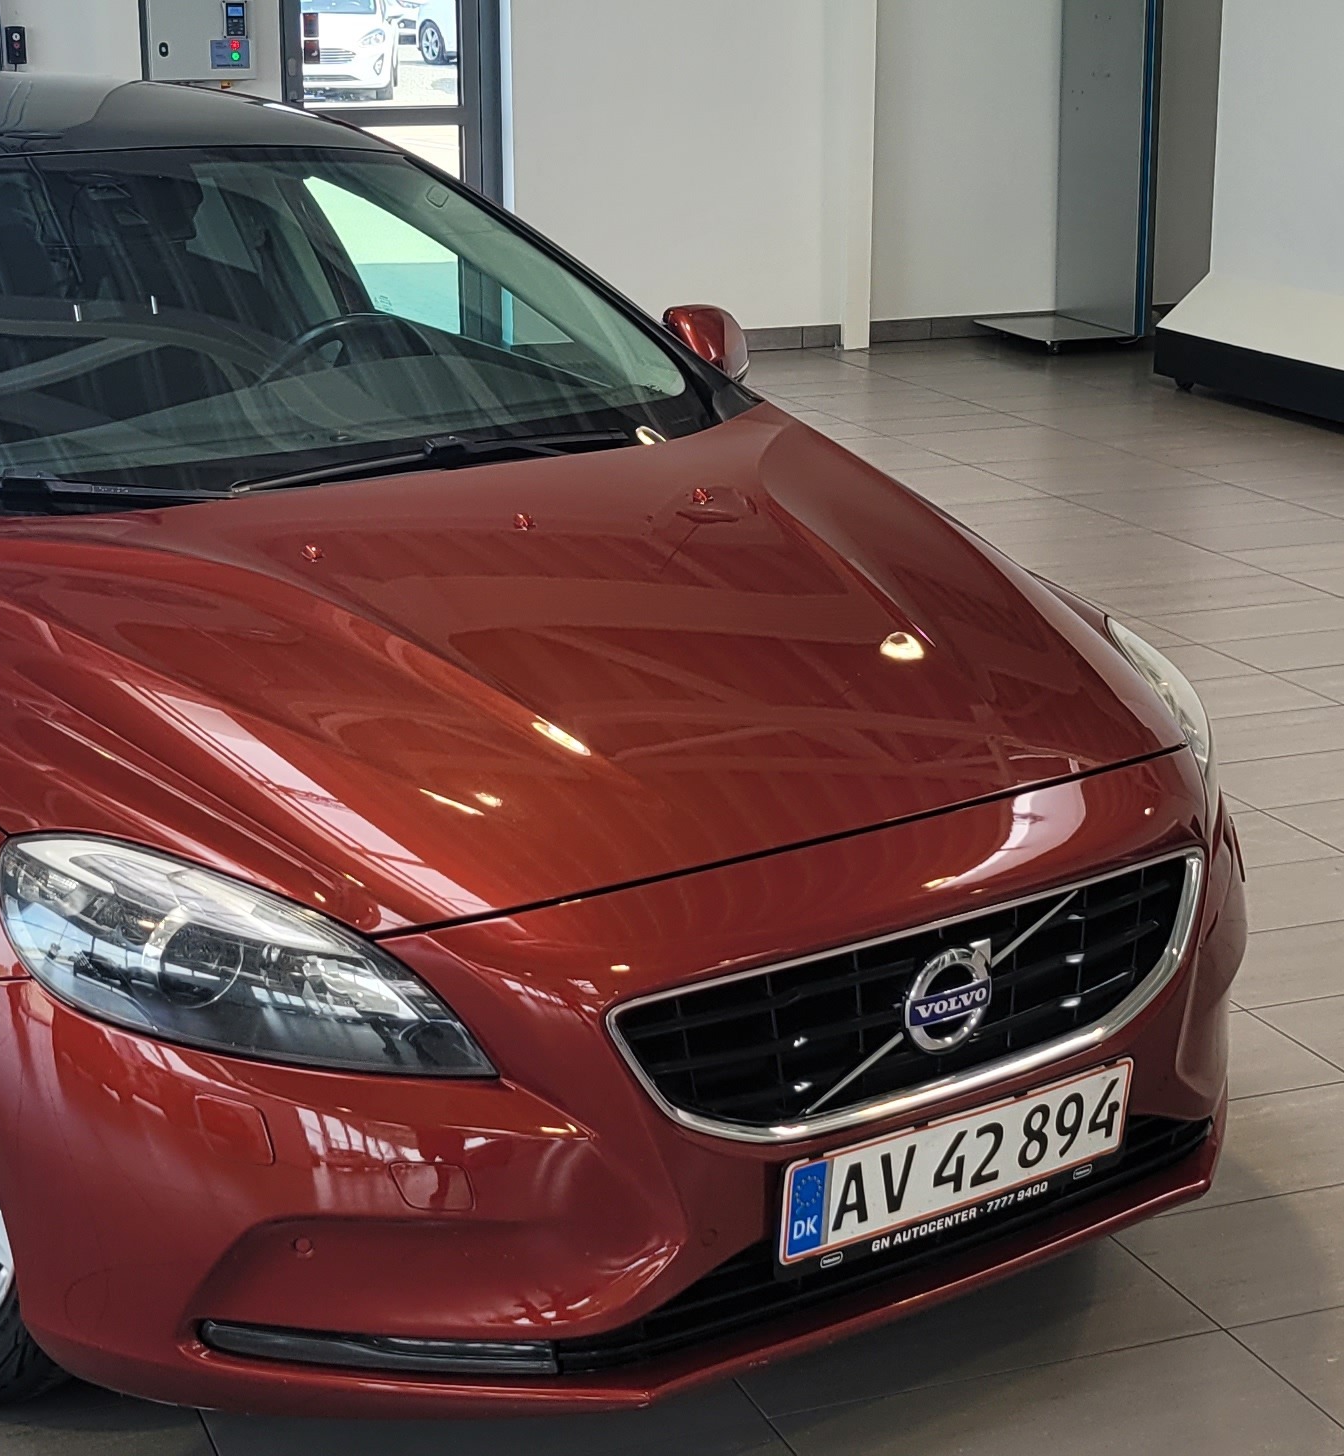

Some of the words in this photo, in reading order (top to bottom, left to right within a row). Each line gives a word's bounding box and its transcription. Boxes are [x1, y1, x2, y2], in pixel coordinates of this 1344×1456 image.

[914, 986, 987, 1019] VOLVO
[831, 1143, 917, 1232] AV
[932, 1121, 1004, 1194] 42
[1017, 1077, 1120, 1169] 894
[792, 1214, 818, 1240] DK
[871, 1235, 890, 1252] GN
[892, 1206, 977, 1246] AUTOCENTER
[986, 1193, 1014, 1213] 7777
[1016, 1181, 1048, 1201] 9400
